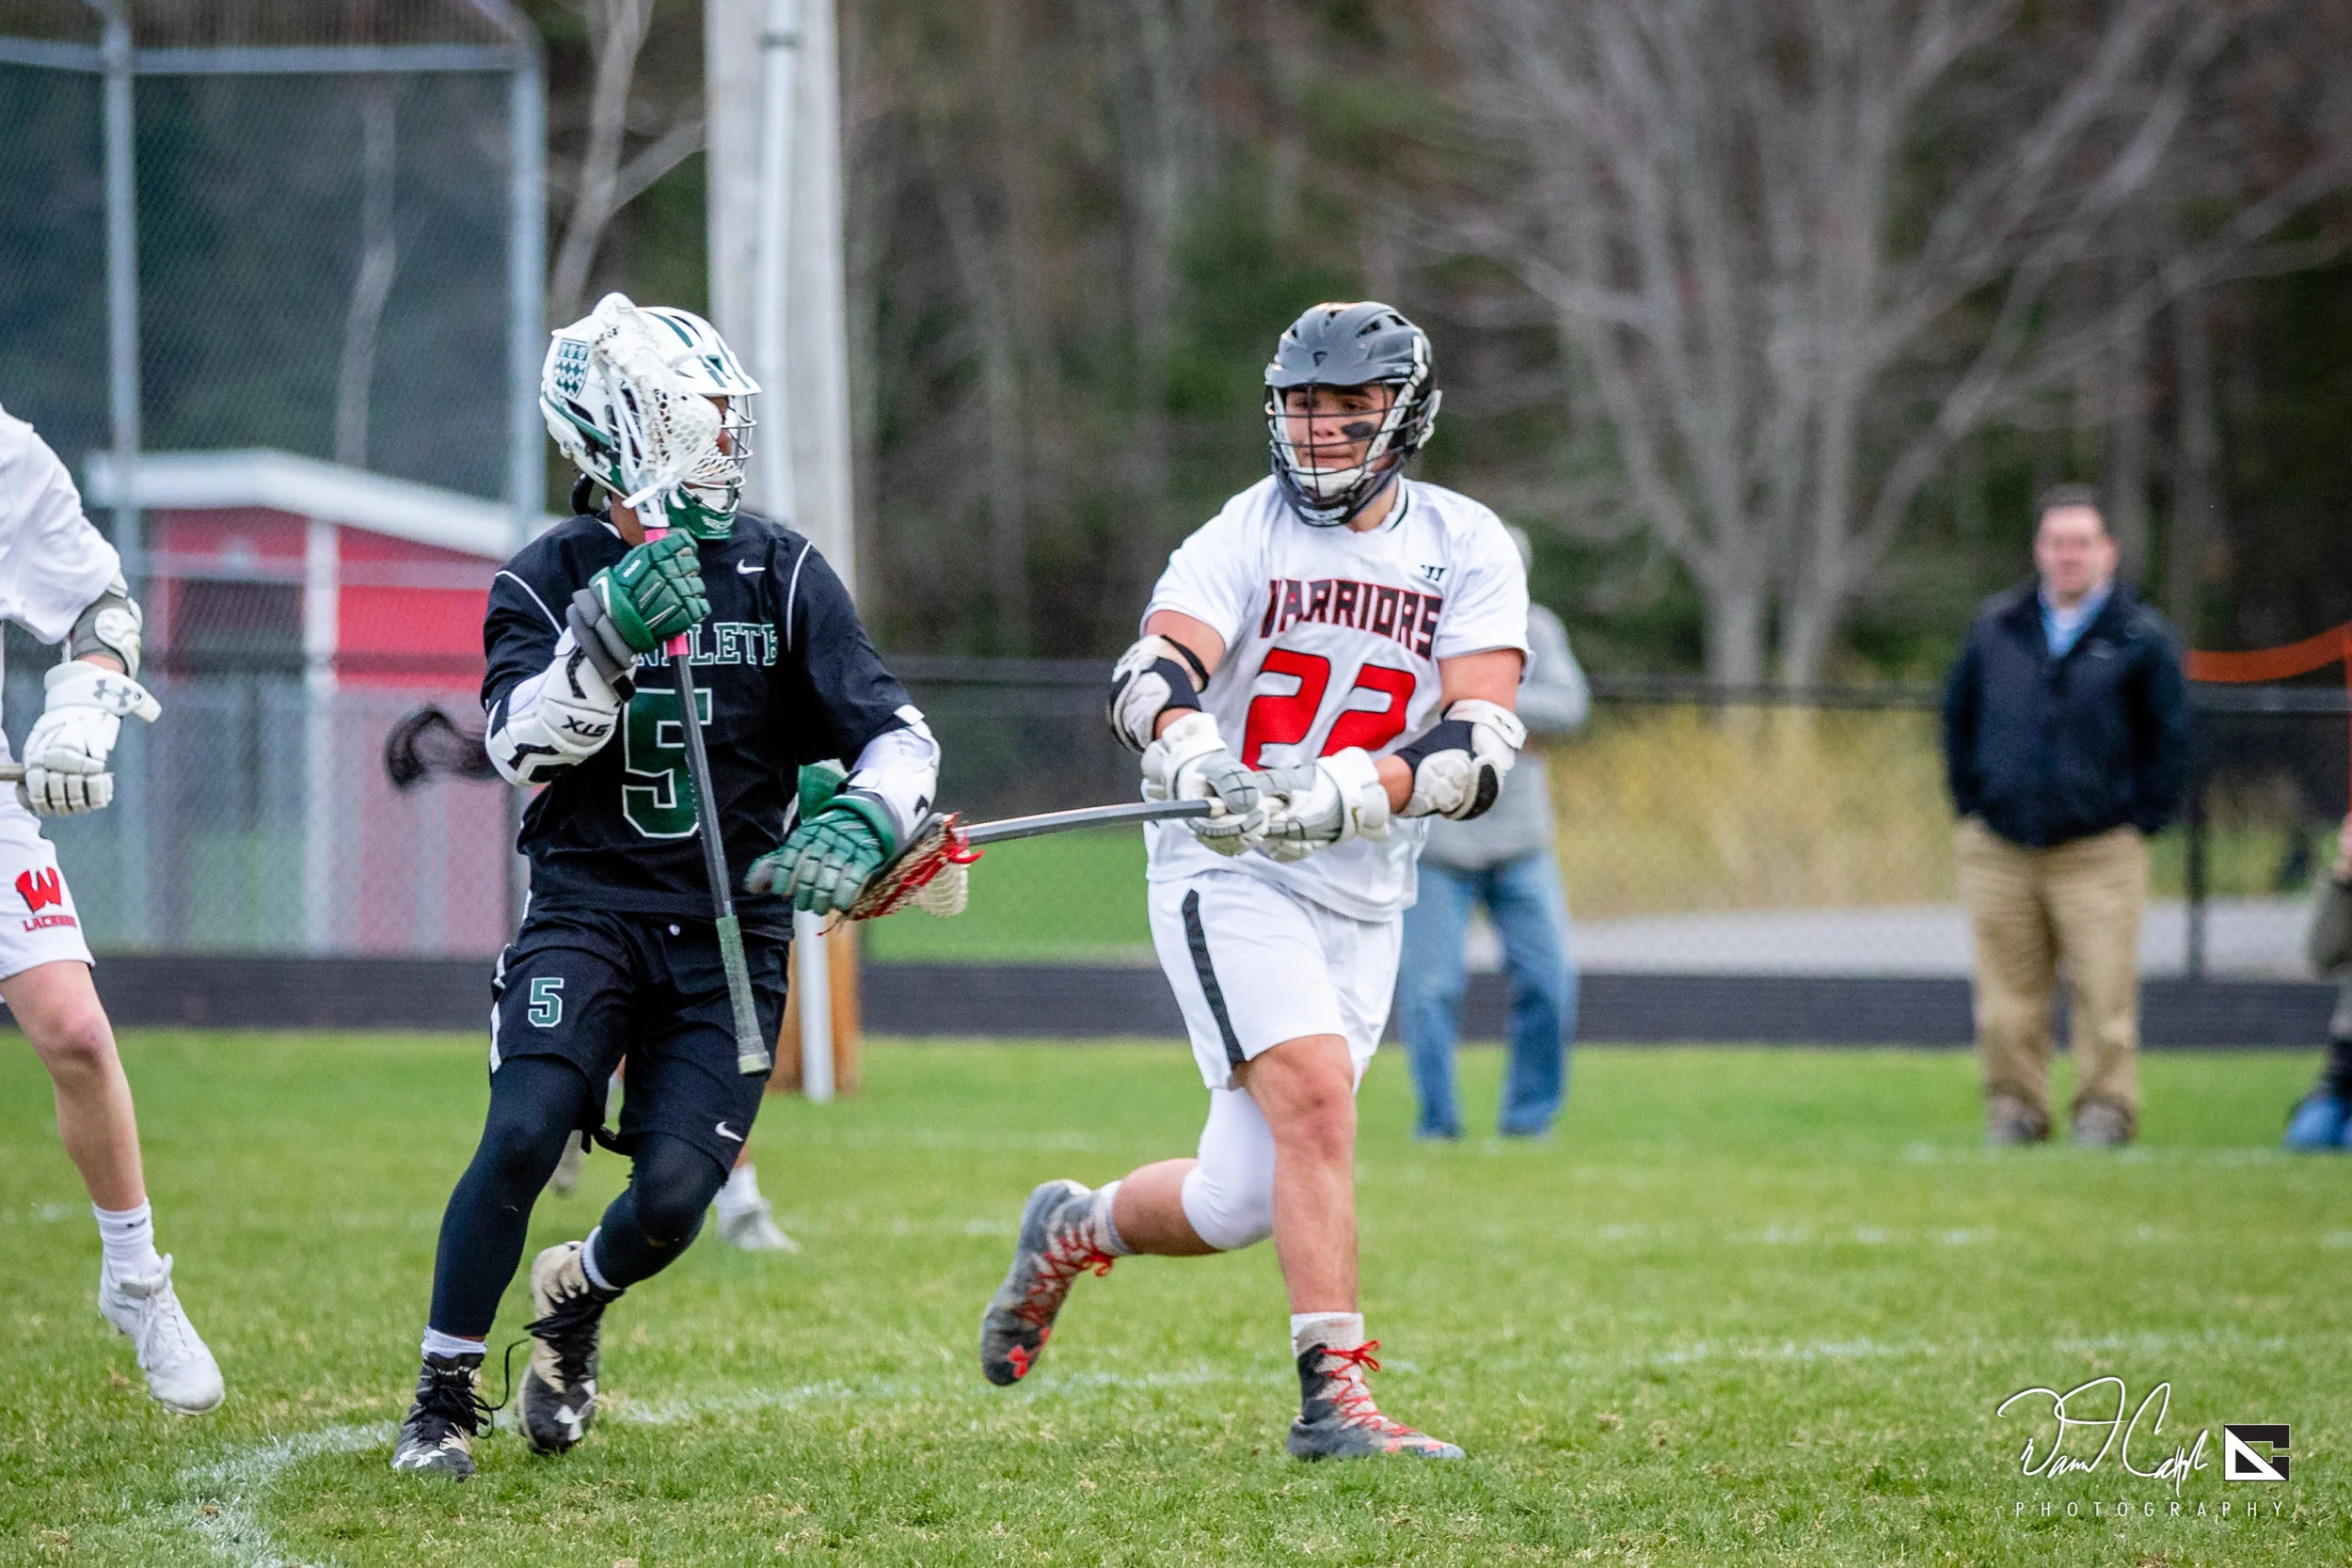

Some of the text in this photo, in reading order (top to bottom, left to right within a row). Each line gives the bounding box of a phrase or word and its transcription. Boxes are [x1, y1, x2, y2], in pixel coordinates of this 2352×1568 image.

[561, 714, 611, 737] STX
[1241, 647, 1417, 772] 22
[621, 687, 713, 839] 5
[15, 865, 62, 915] W
[528, 976, 564, 1028] 5
